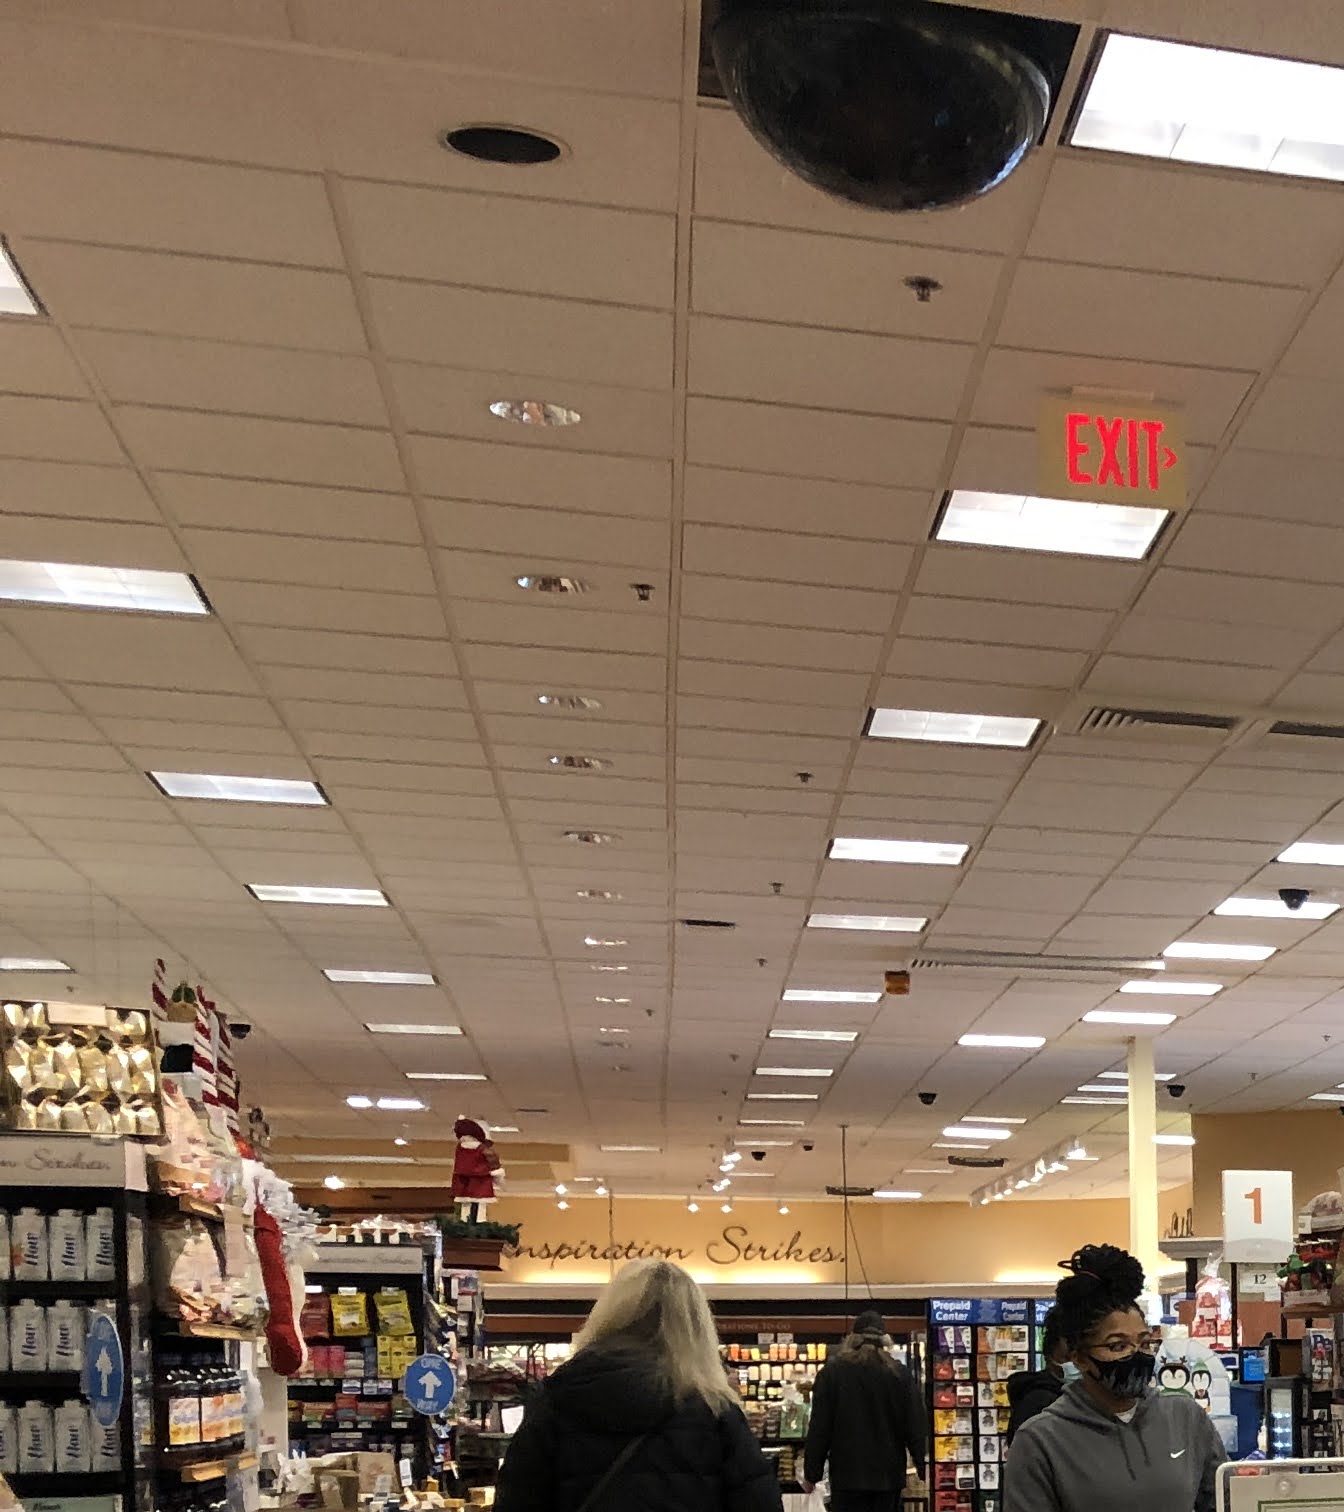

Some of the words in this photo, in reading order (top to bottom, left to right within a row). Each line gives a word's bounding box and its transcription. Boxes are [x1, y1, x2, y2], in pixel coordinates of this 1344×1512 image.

[1066, 413, 1164, 490] EXIT
[1244, 1187, 1262, 1224] 1
[1253, 1273, 1267, 1285] 12
[933, 1301, 971, 1311] Prepaid
[935, 1311, 968, 1321] Center
